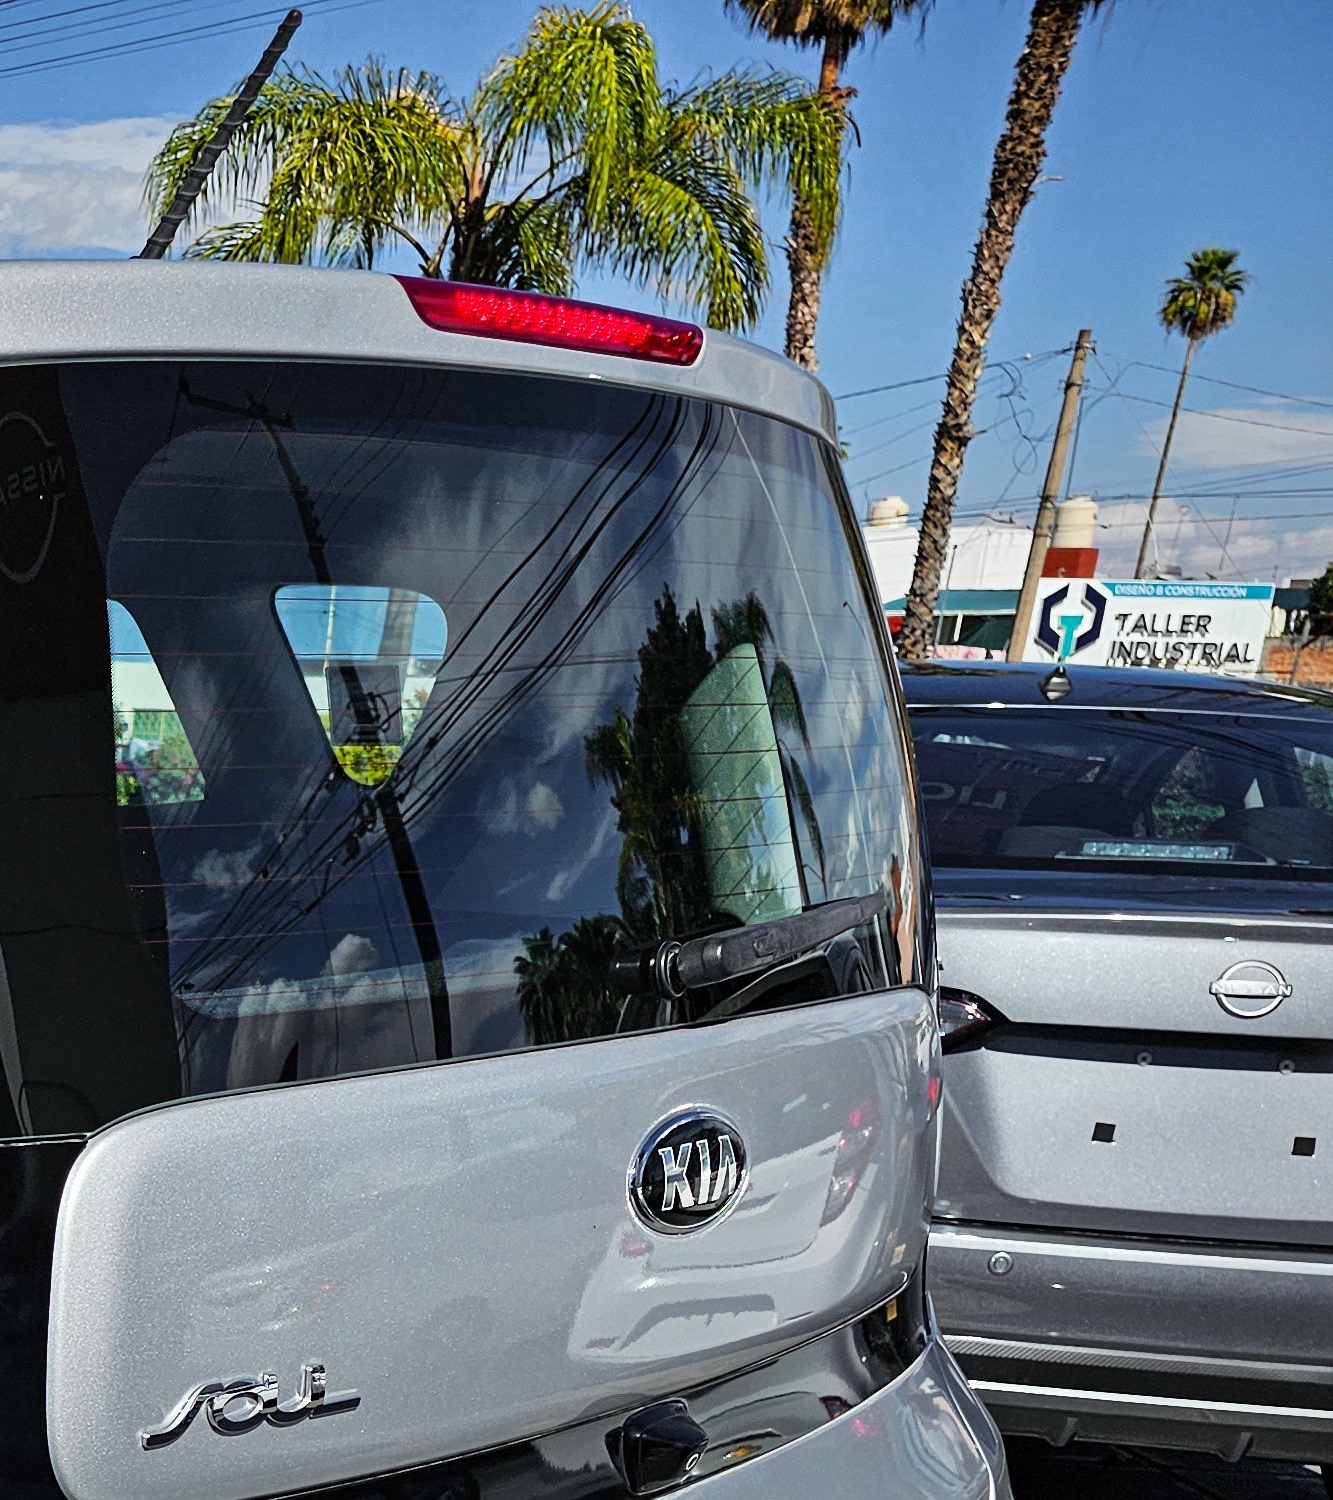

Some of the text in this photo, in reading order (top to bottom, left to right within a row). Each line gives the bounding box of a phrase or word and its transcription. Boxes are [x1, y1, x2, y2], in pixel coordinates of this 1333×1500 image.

[1115, 613, 1212, 637] TALLER
[1109, 640, 1256, 665] INDUSTRIAL
[1210, 980, 1293, 997] NIAN
[657, 1134, 738, 1212] KIA
